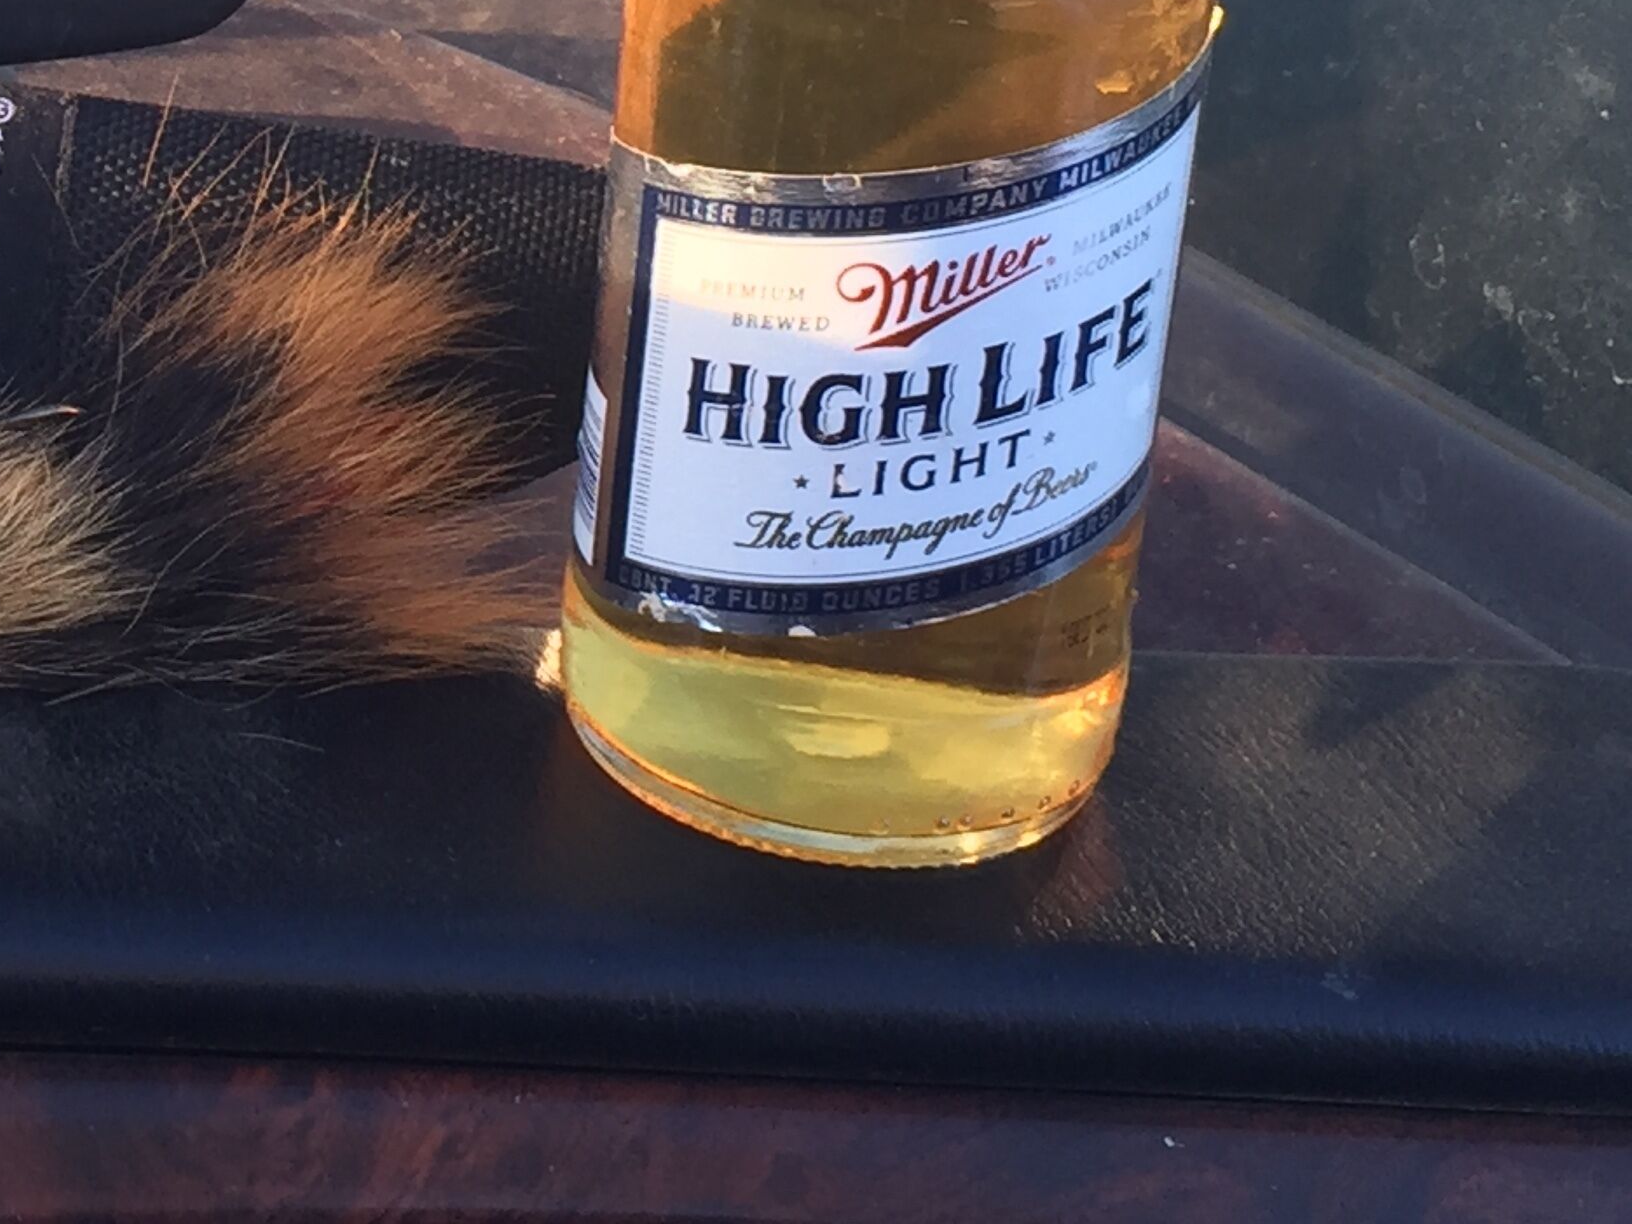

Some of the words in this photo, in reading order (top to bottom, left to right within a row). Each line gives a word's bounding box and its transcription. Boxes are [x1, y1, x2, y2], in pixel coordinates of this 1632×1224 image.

[655, 192, 737, 225] MILLER
[749, 206, 887, 230] BREWING
[900, 178, 1049, 226] COMPANY
[1072, 182, 1172, 258] MILWAUKEE
[699, 279, 806, 301] PREMIUM
[837, 233, 1052, 338] Miller
[1044, 226, 1152, 293] WISCONSIN
[731, 311, 831, 333] BREWED
[682, 357, 956, 450] HIGH
[972, 278, 1156, 427] LIFE
[830, 429, 1032, 500] LIGHT
[734, 510, 803, 550] The
[805, 508, 984, 560] Champagne
[983, 482, 1022, 540] of
[1010, 462, 1091, 516] Beers
[821, 578, 942, 612] OUNCES
